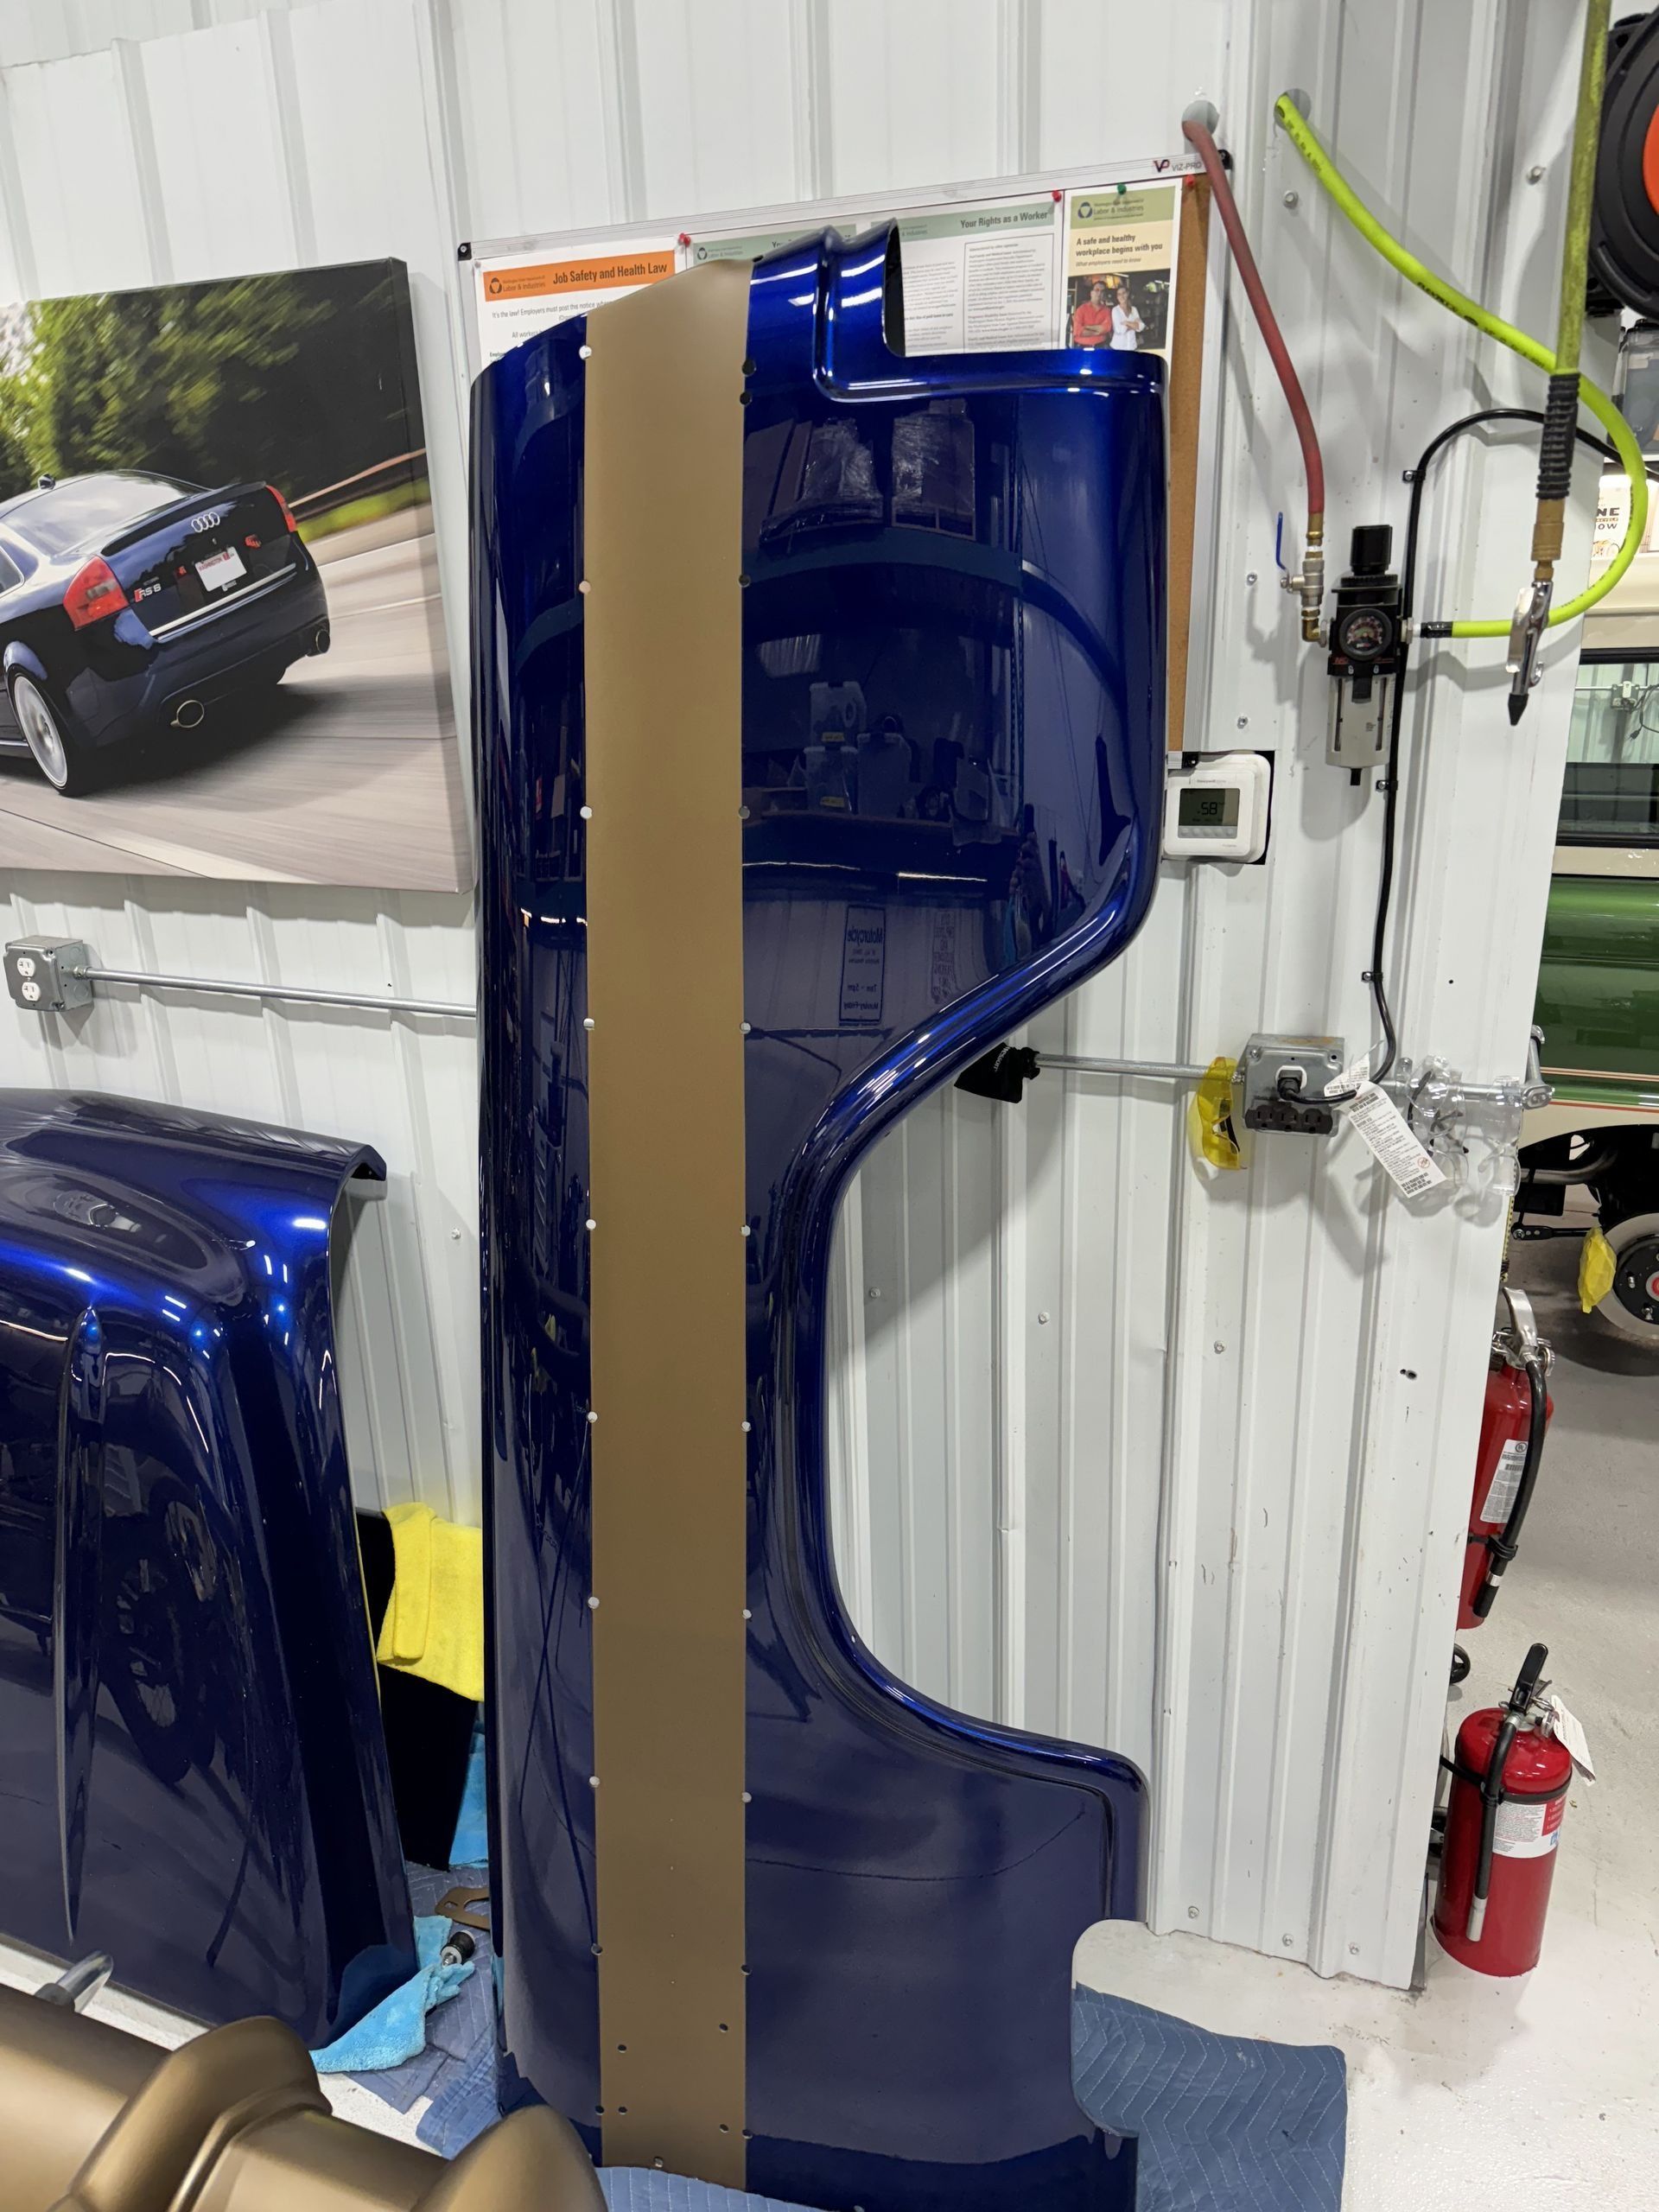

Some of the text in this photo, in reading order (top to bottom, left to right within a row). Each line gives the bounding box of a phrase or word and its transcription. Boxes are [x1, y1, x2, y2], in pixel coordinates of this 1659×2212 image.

[1172, 162, 1202, 171] VIZ-PRO
[961, 219, 977, 228] Your
[978, 216, 1001, 228] Rights
[1020, 211, 1049, 221] Worker
[1083, 237, 1097, 245] safe
[1112, 234, 1136, 243] healthy
[1076, 243, 1163, 257] workplace begins with you
[553, 272, 569, 284] Job
[570, 269, 597, 283] Safety
[600, 266, 615, 279] and
[618, 264, 645, 277] Health
[648, 263, 667, 274] Law
[520, 308, 545, 317] Employers
[559, 304, 569, 313] post
